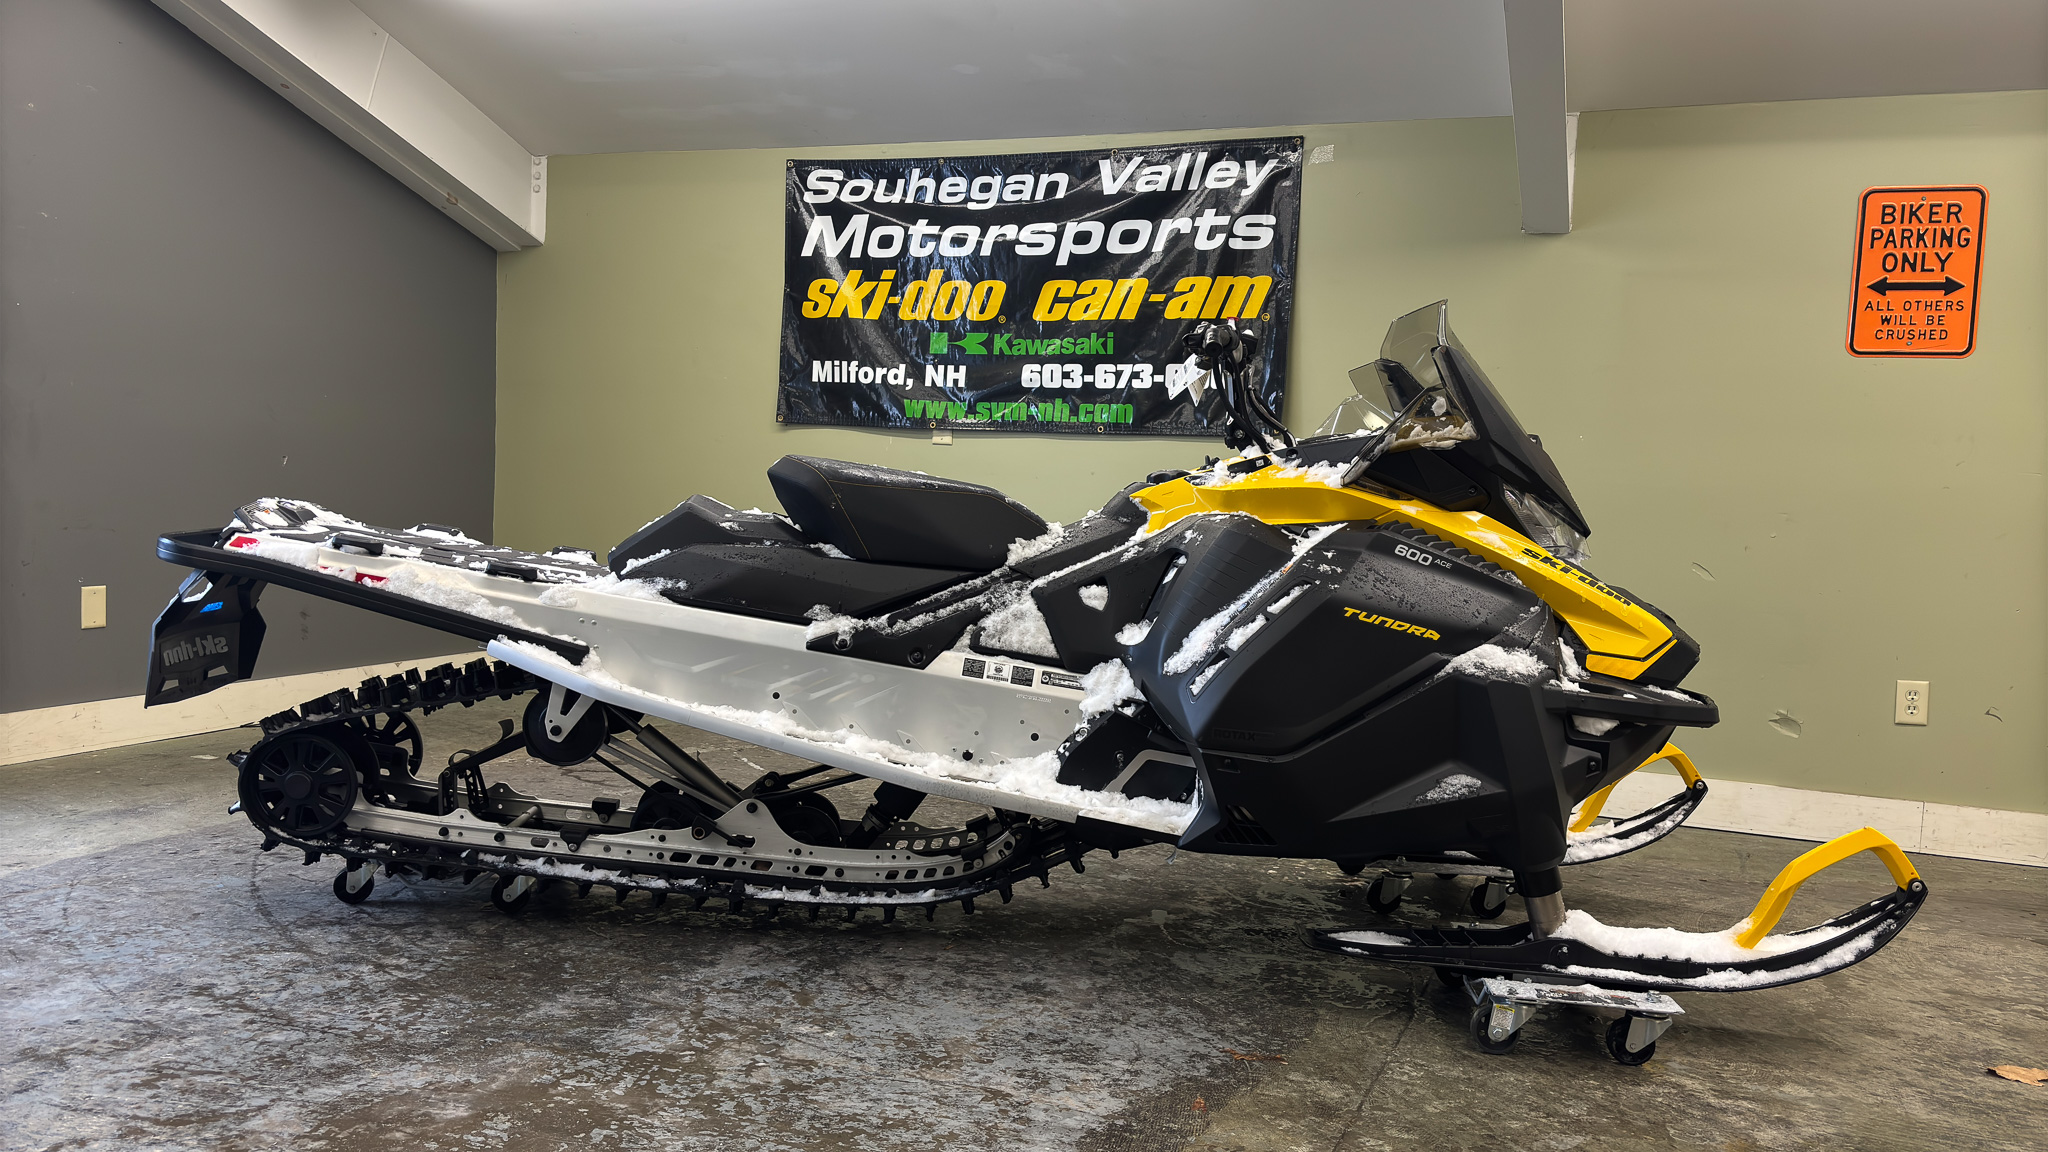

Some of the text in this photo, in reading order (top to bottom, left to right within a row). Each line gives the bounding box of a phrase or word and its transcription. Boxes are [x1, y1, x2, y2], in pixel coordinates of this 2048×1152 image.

[803, 151, 1279, 210] Souhegan Valley
[1880, 203, 1963, 225] BIKER
[801, 207, 1277, 266] Motorsports
[1869, 227, 1972, 249] PARKING
[1881, 251, 1954, 273] ONLY
[801, 269, 1273, 322] ski-doo can-am
[1864, 300, 1965, 312] ALL OTHERS
[1880, 314, 1946, 326] WILL BE
[993, 332, 1114, 356] Kawasaki
[1874, 329, 1949, 341] CRUSHED
[811, 360, 914, 391] Milford,
[925, 364, 967, 388] NH
[903, 398, 1134, 424] www.svm-nh.com
[1394, 544, 1453, 569] 600 ACE
[1521, 548, 1632, 606] ski-doo
[1344, 607, 1441, 641] TUNDRA
